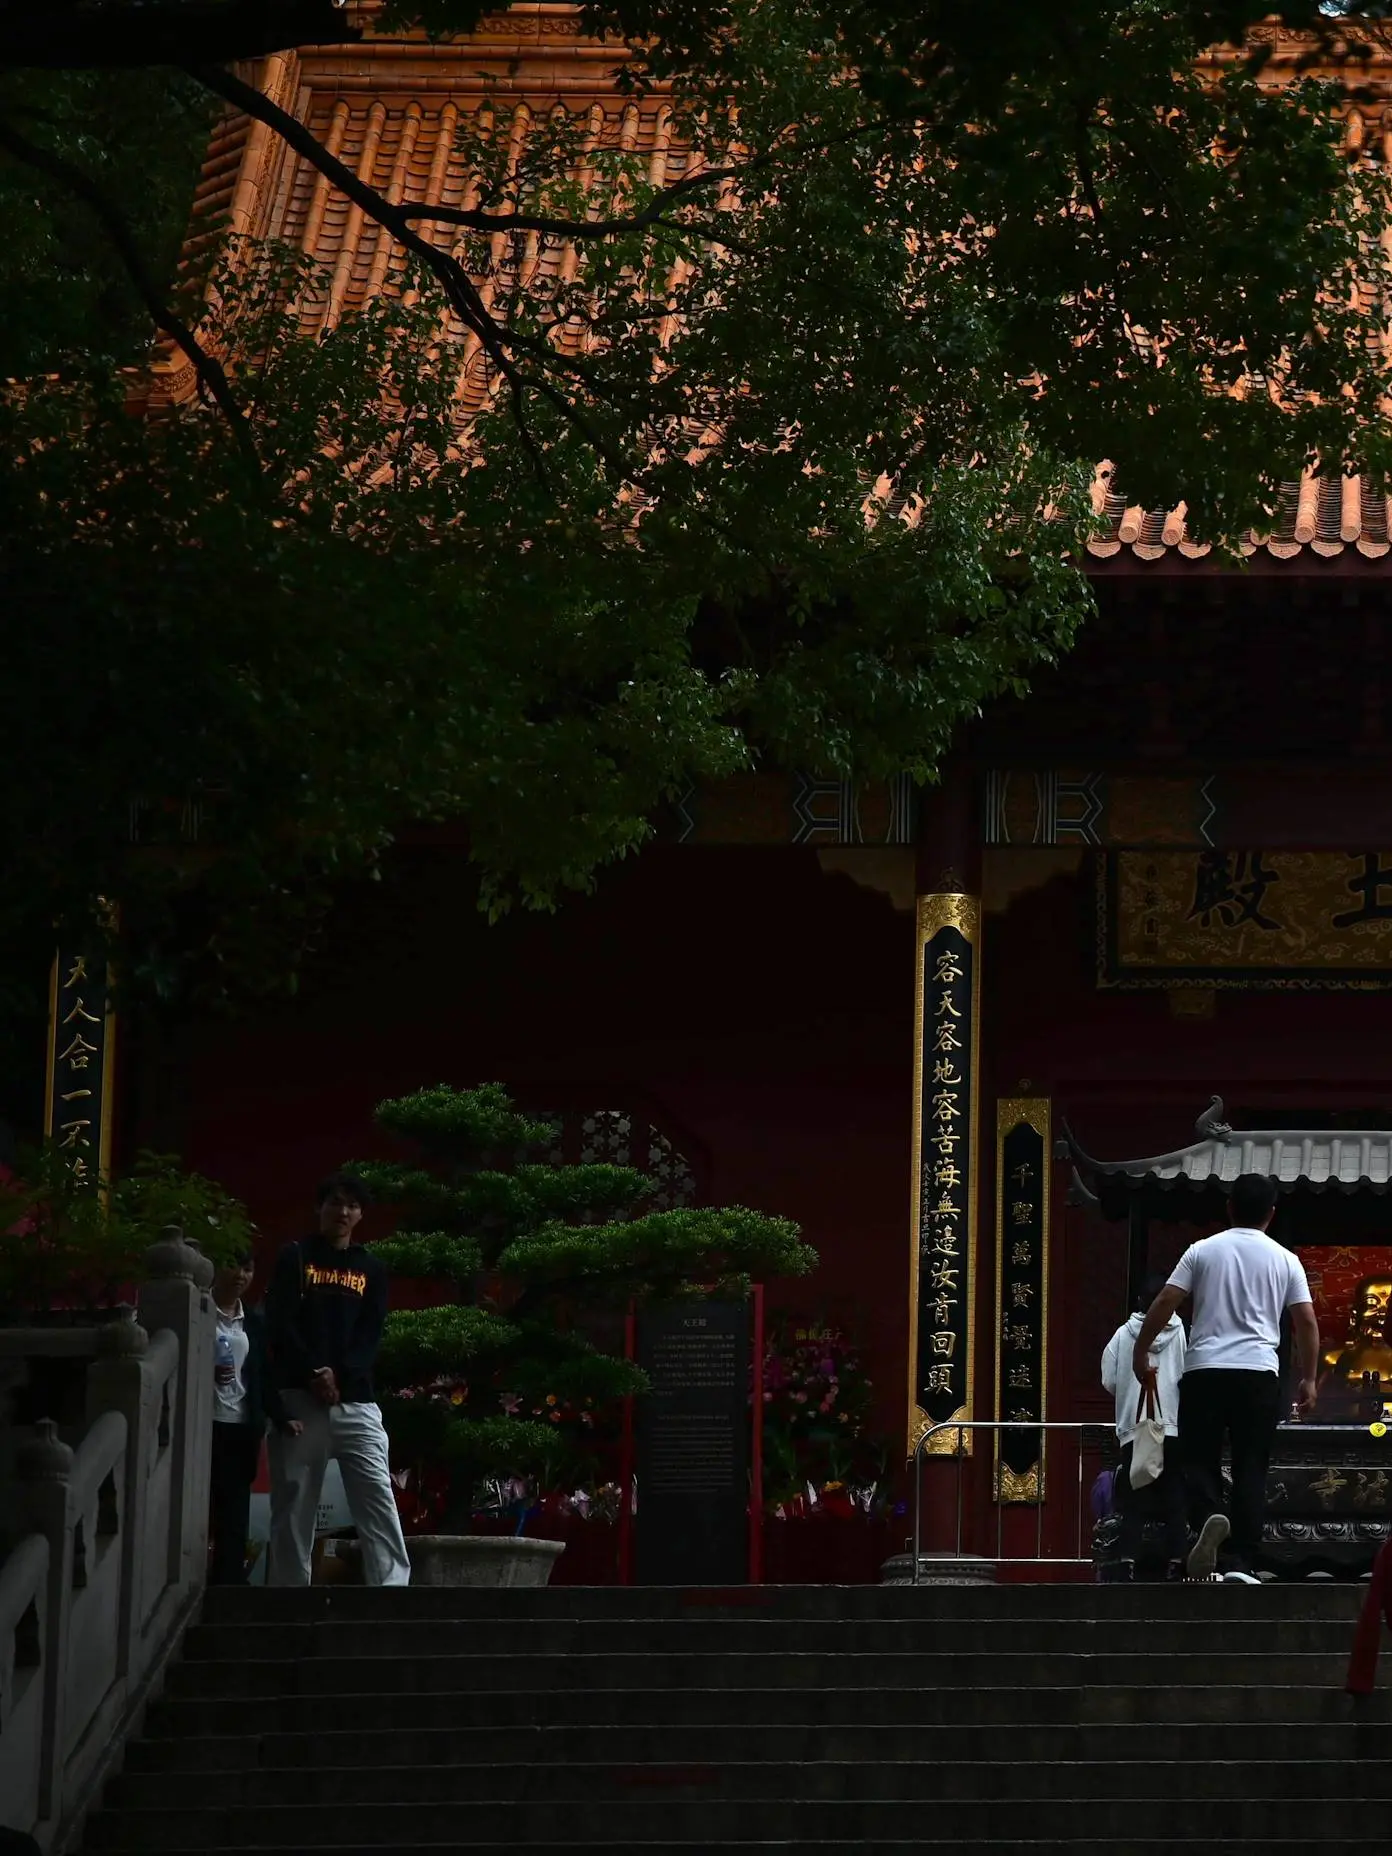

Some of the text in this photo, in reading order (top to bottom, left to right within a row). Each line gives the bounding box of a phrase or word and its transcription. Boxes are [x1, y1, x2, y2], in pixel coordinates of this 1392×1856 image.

[57, 955, 101, 1194] 天人合一不
